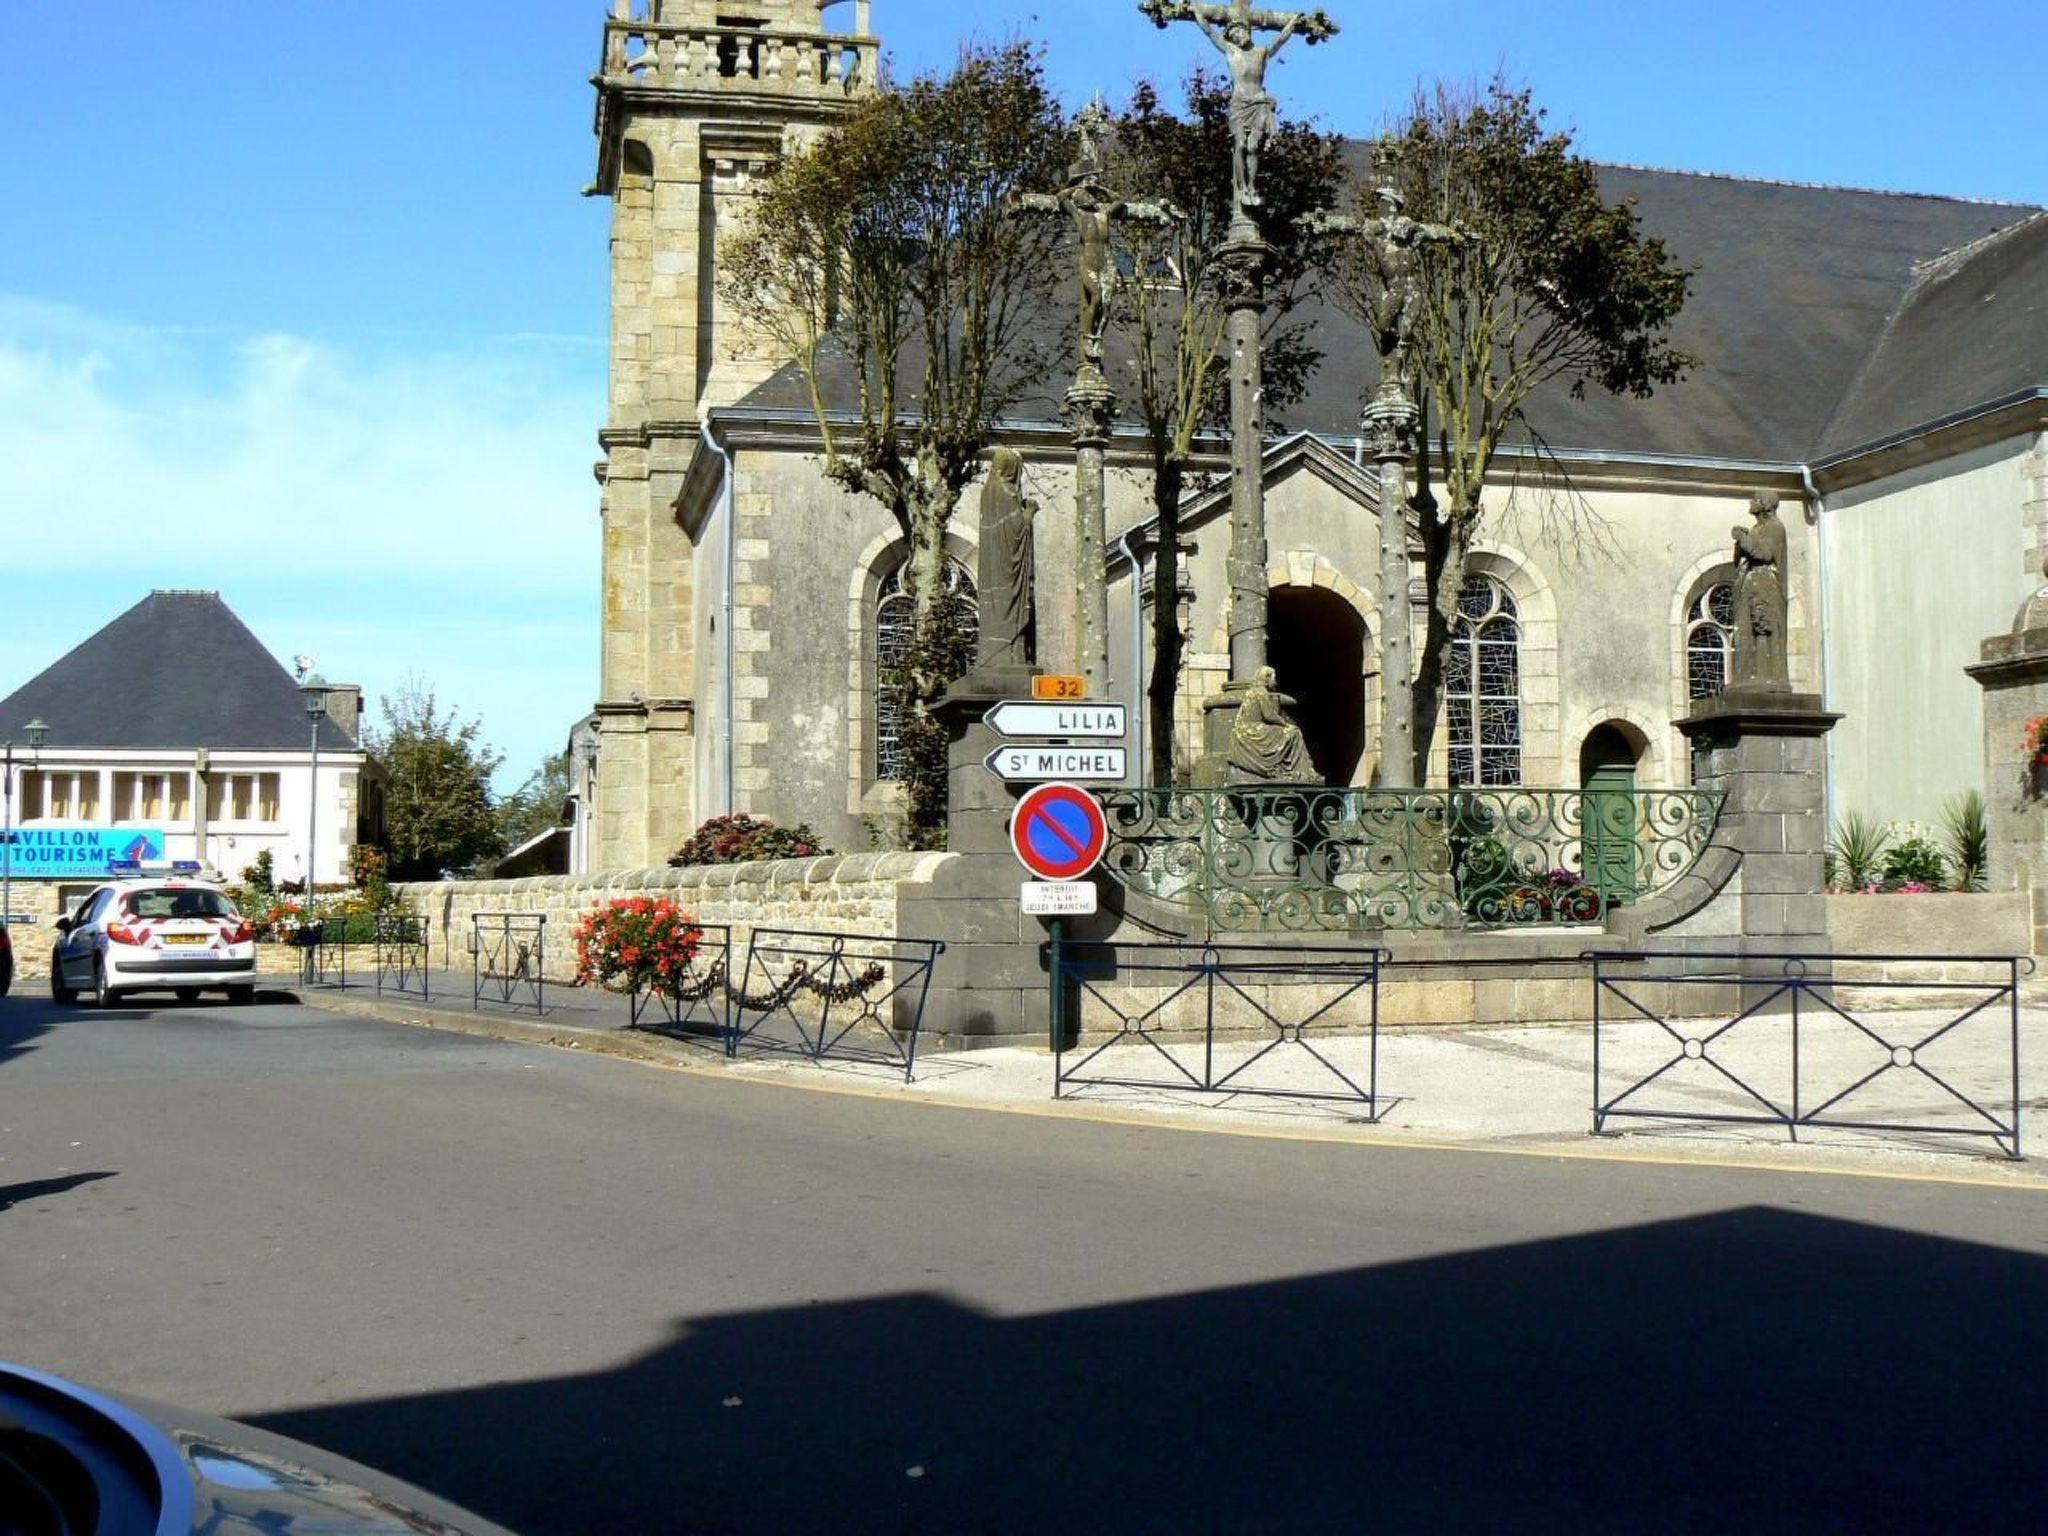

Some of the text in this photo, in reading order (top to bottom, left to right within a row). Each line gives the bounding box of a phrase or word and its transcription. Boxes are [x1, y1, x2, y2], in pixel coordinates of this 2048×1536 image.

[1056, 680, 1079, 697] 32
[1058, 712, 1117, 729] LILIA
[1010, 754, 1117, 772] ST MICHEL
[12, 847, 116, 862] TOURISME
